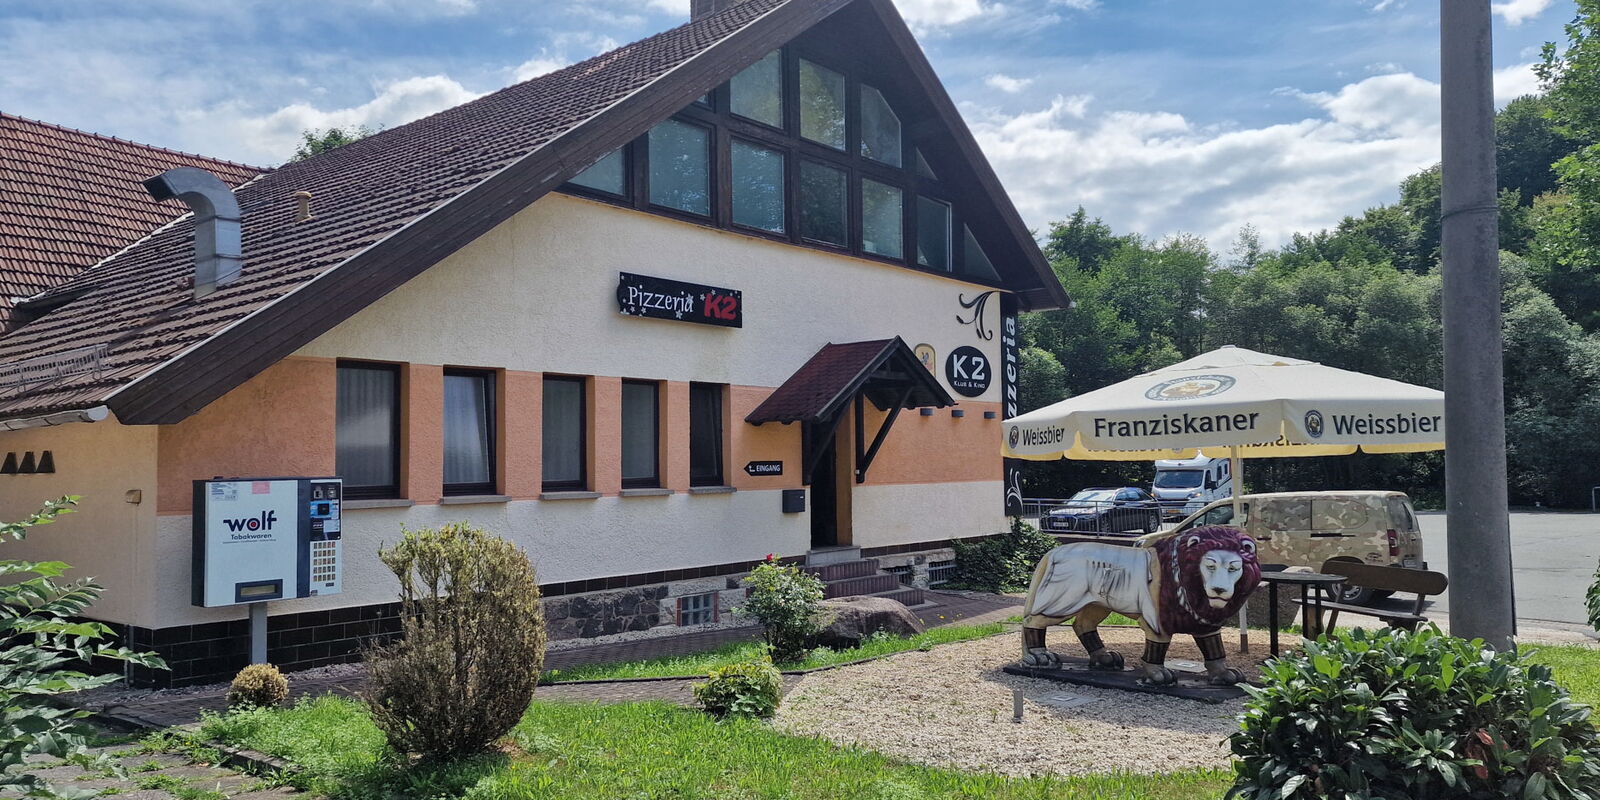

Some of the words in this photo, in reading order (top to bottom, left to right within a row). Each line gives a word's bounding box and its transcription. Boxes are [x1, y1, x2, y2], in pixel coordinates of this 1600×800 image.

[627, 284, 694, 313] Pizzeria
[703, 293, 737, 321] K2
[953, 354, 985, 380] K2
[1003, 317, 1017, 418] zzeria
[1022, 425, 1065, 446] Weissbier
[1094, 411, 1259, 437] Franziskaner
[1332, 412, 1442, 436] Weissbier
[222, 510, 277, 532] wolf
